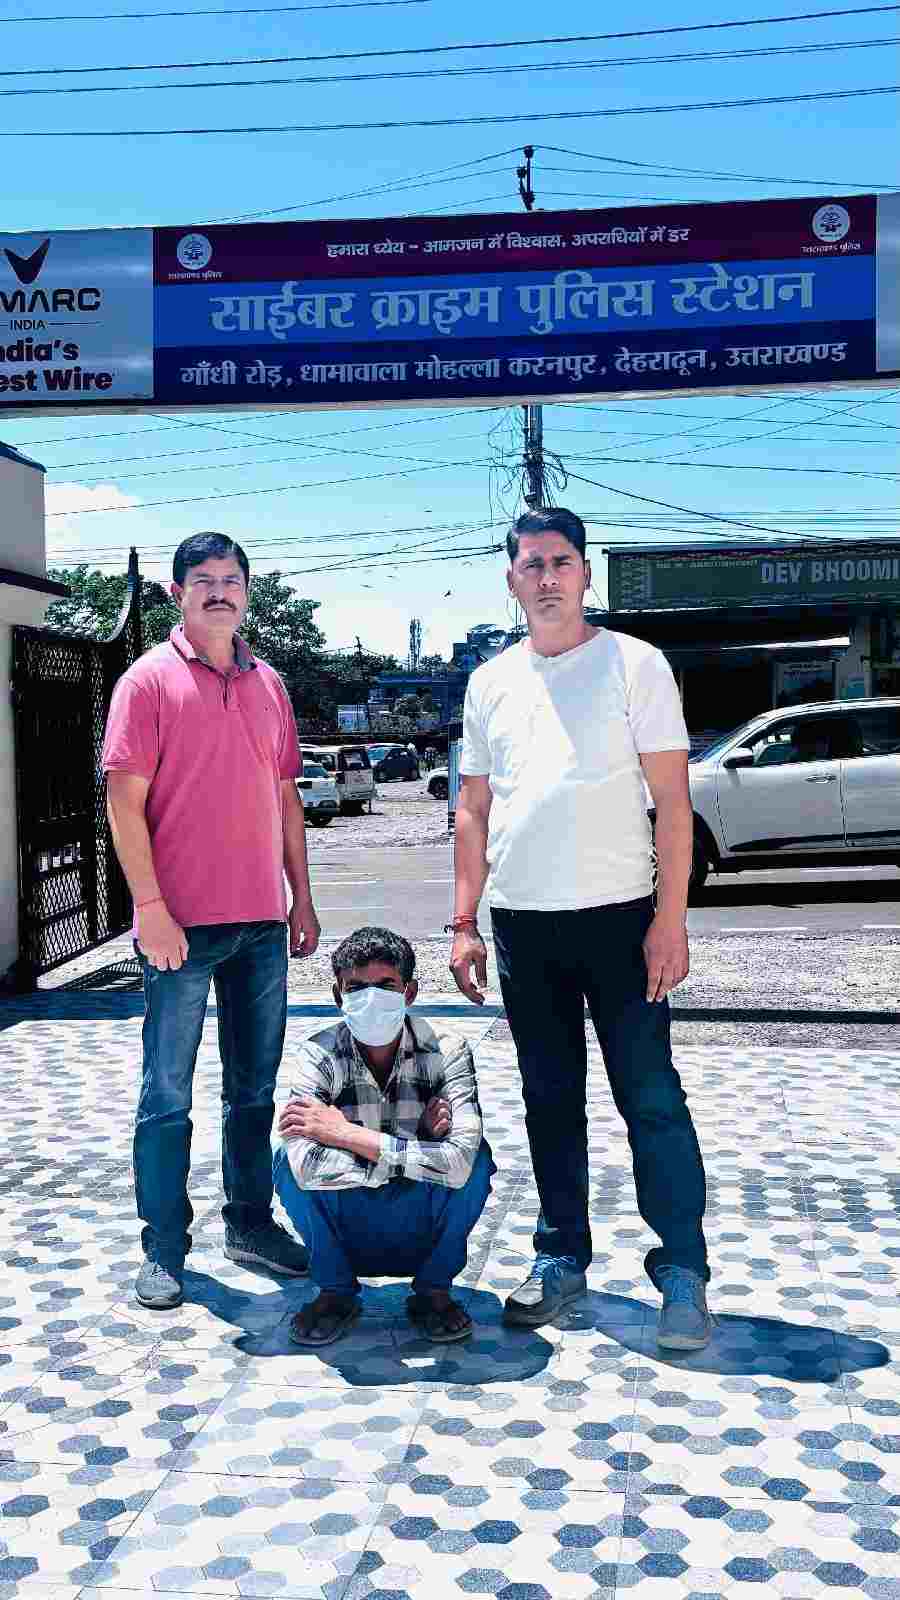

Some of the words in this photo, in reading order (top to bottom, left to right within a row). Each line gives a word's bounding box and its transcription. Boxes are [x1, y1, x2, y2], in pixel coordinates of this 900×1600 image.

[327, 243, 369, 258] हमारा
[374, 238, 405, 255] ध्येय
[423, 238, 484, 254] आमजन
[488, 233, 505, 249] में
[571, 226, 648, 247] अपराधियों
[650, 225, 667, 243] में
[668, 228, 692, 243] डर
[209, 281, 356, 340] साईबर
[370, 286, 503, 335] क्राइम
[515, 270, 656, 335] पुलिस
[669, 263, 816, 315] स्टेशन
[10, 320, 46, 331] INDIA
[43, 366, 113, 391] Wire
[180, 359, 238, 386] गाँधी
[300, 361, 409, 385] धामावाला
[415, 354, 501, 380] मोहल्ला
[724, 342, 848, 367] उत्तराखण्ड
[760, 561, 802, 584] DEV
[811, 559, 900, 582] BHOOMI
